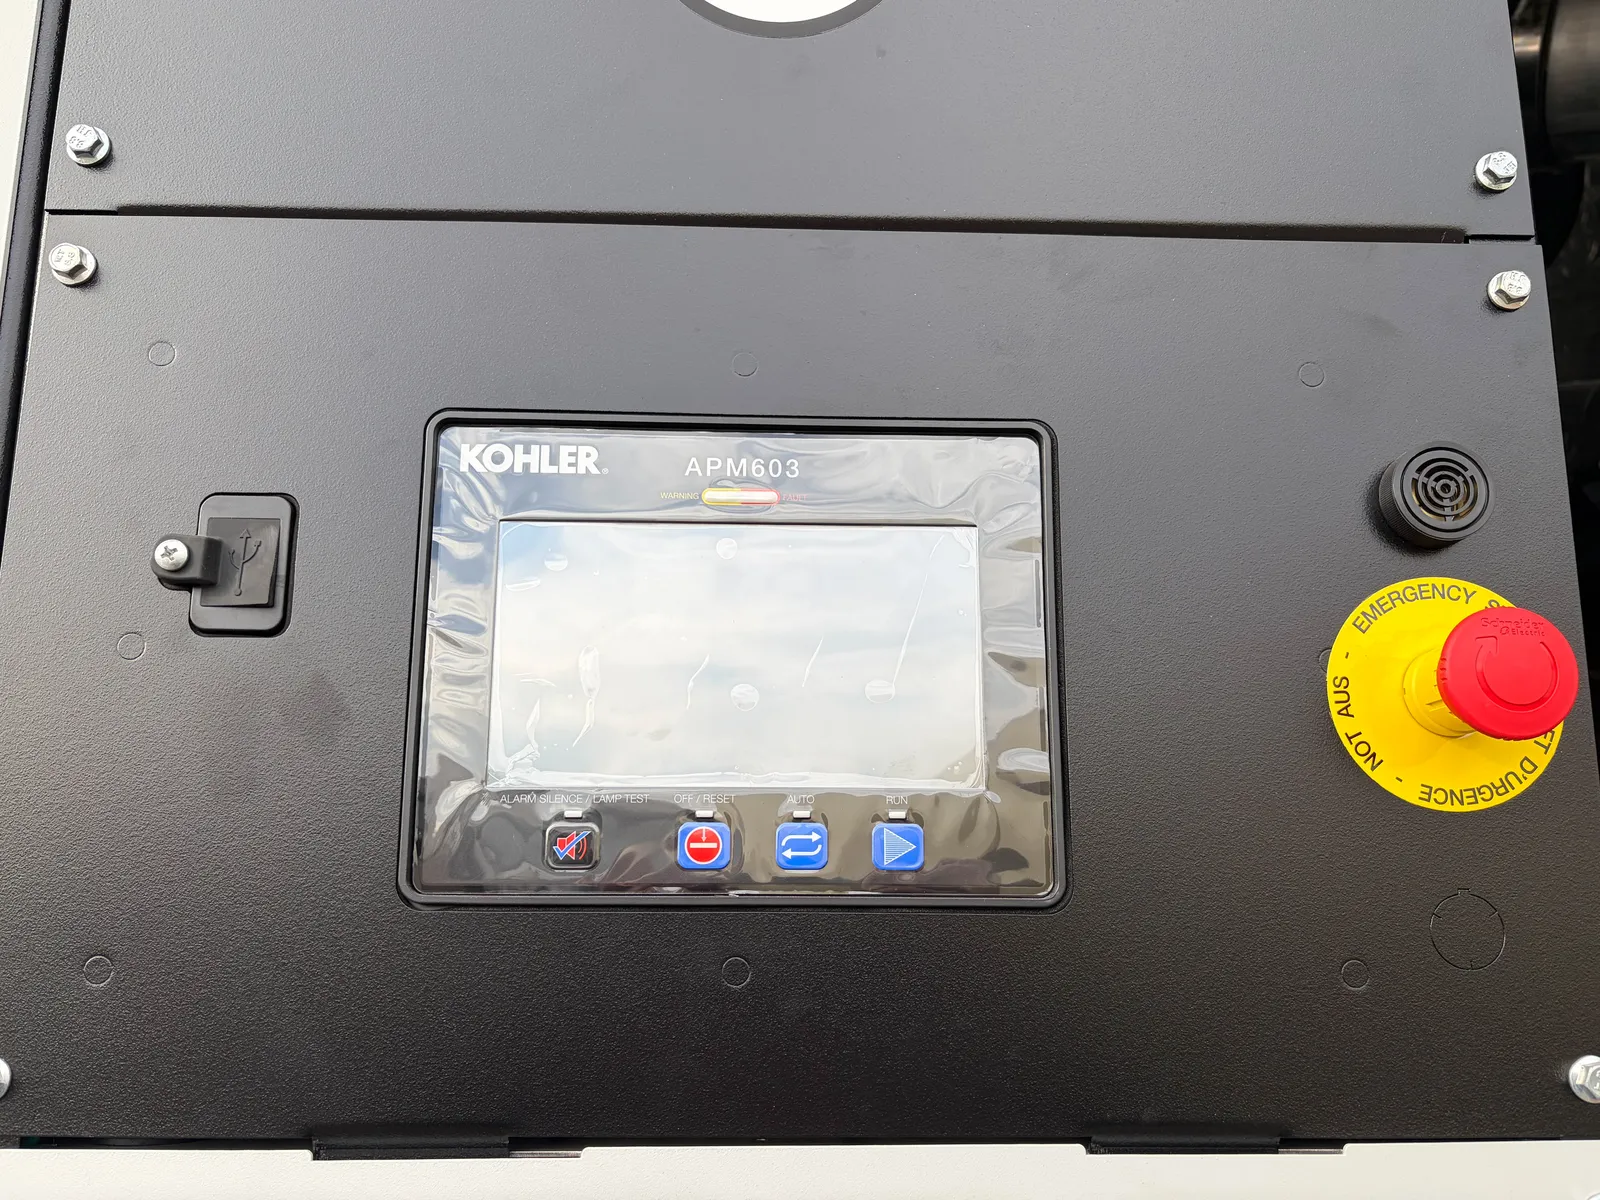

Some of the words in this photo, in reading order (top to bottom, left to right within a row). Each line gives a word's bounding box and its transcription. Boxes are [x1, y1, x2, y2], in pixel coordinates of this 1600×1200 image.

[459, 443, 601, 475] KOHLER
[684, 457, 800, 478] APM603
[660, 491, 700, 500] WARNING
[782, 493, 808, 501] FAULT
[1352, 583, 1477, 634] EMERGENCY
[1511, 628, 1545, 637] Electric
[1332, 675, 1355, 719] AUS
[1345, 731, 1384, 772] NOT
[1418, 756, 1539, 806] D'URGENCE
[500, 794, 537, 804] ALARM
[539, 794, 583, 804] SILENCE
[593, 794, 622, 804] LAMP
[625, 794, 650, 804] TEST
[673, 794, 694, 804] OFF
[703, 794, 736, 804] RESET
[786, 794, 815, 805] AUTO
[886, 795, 908, 805] RUN
